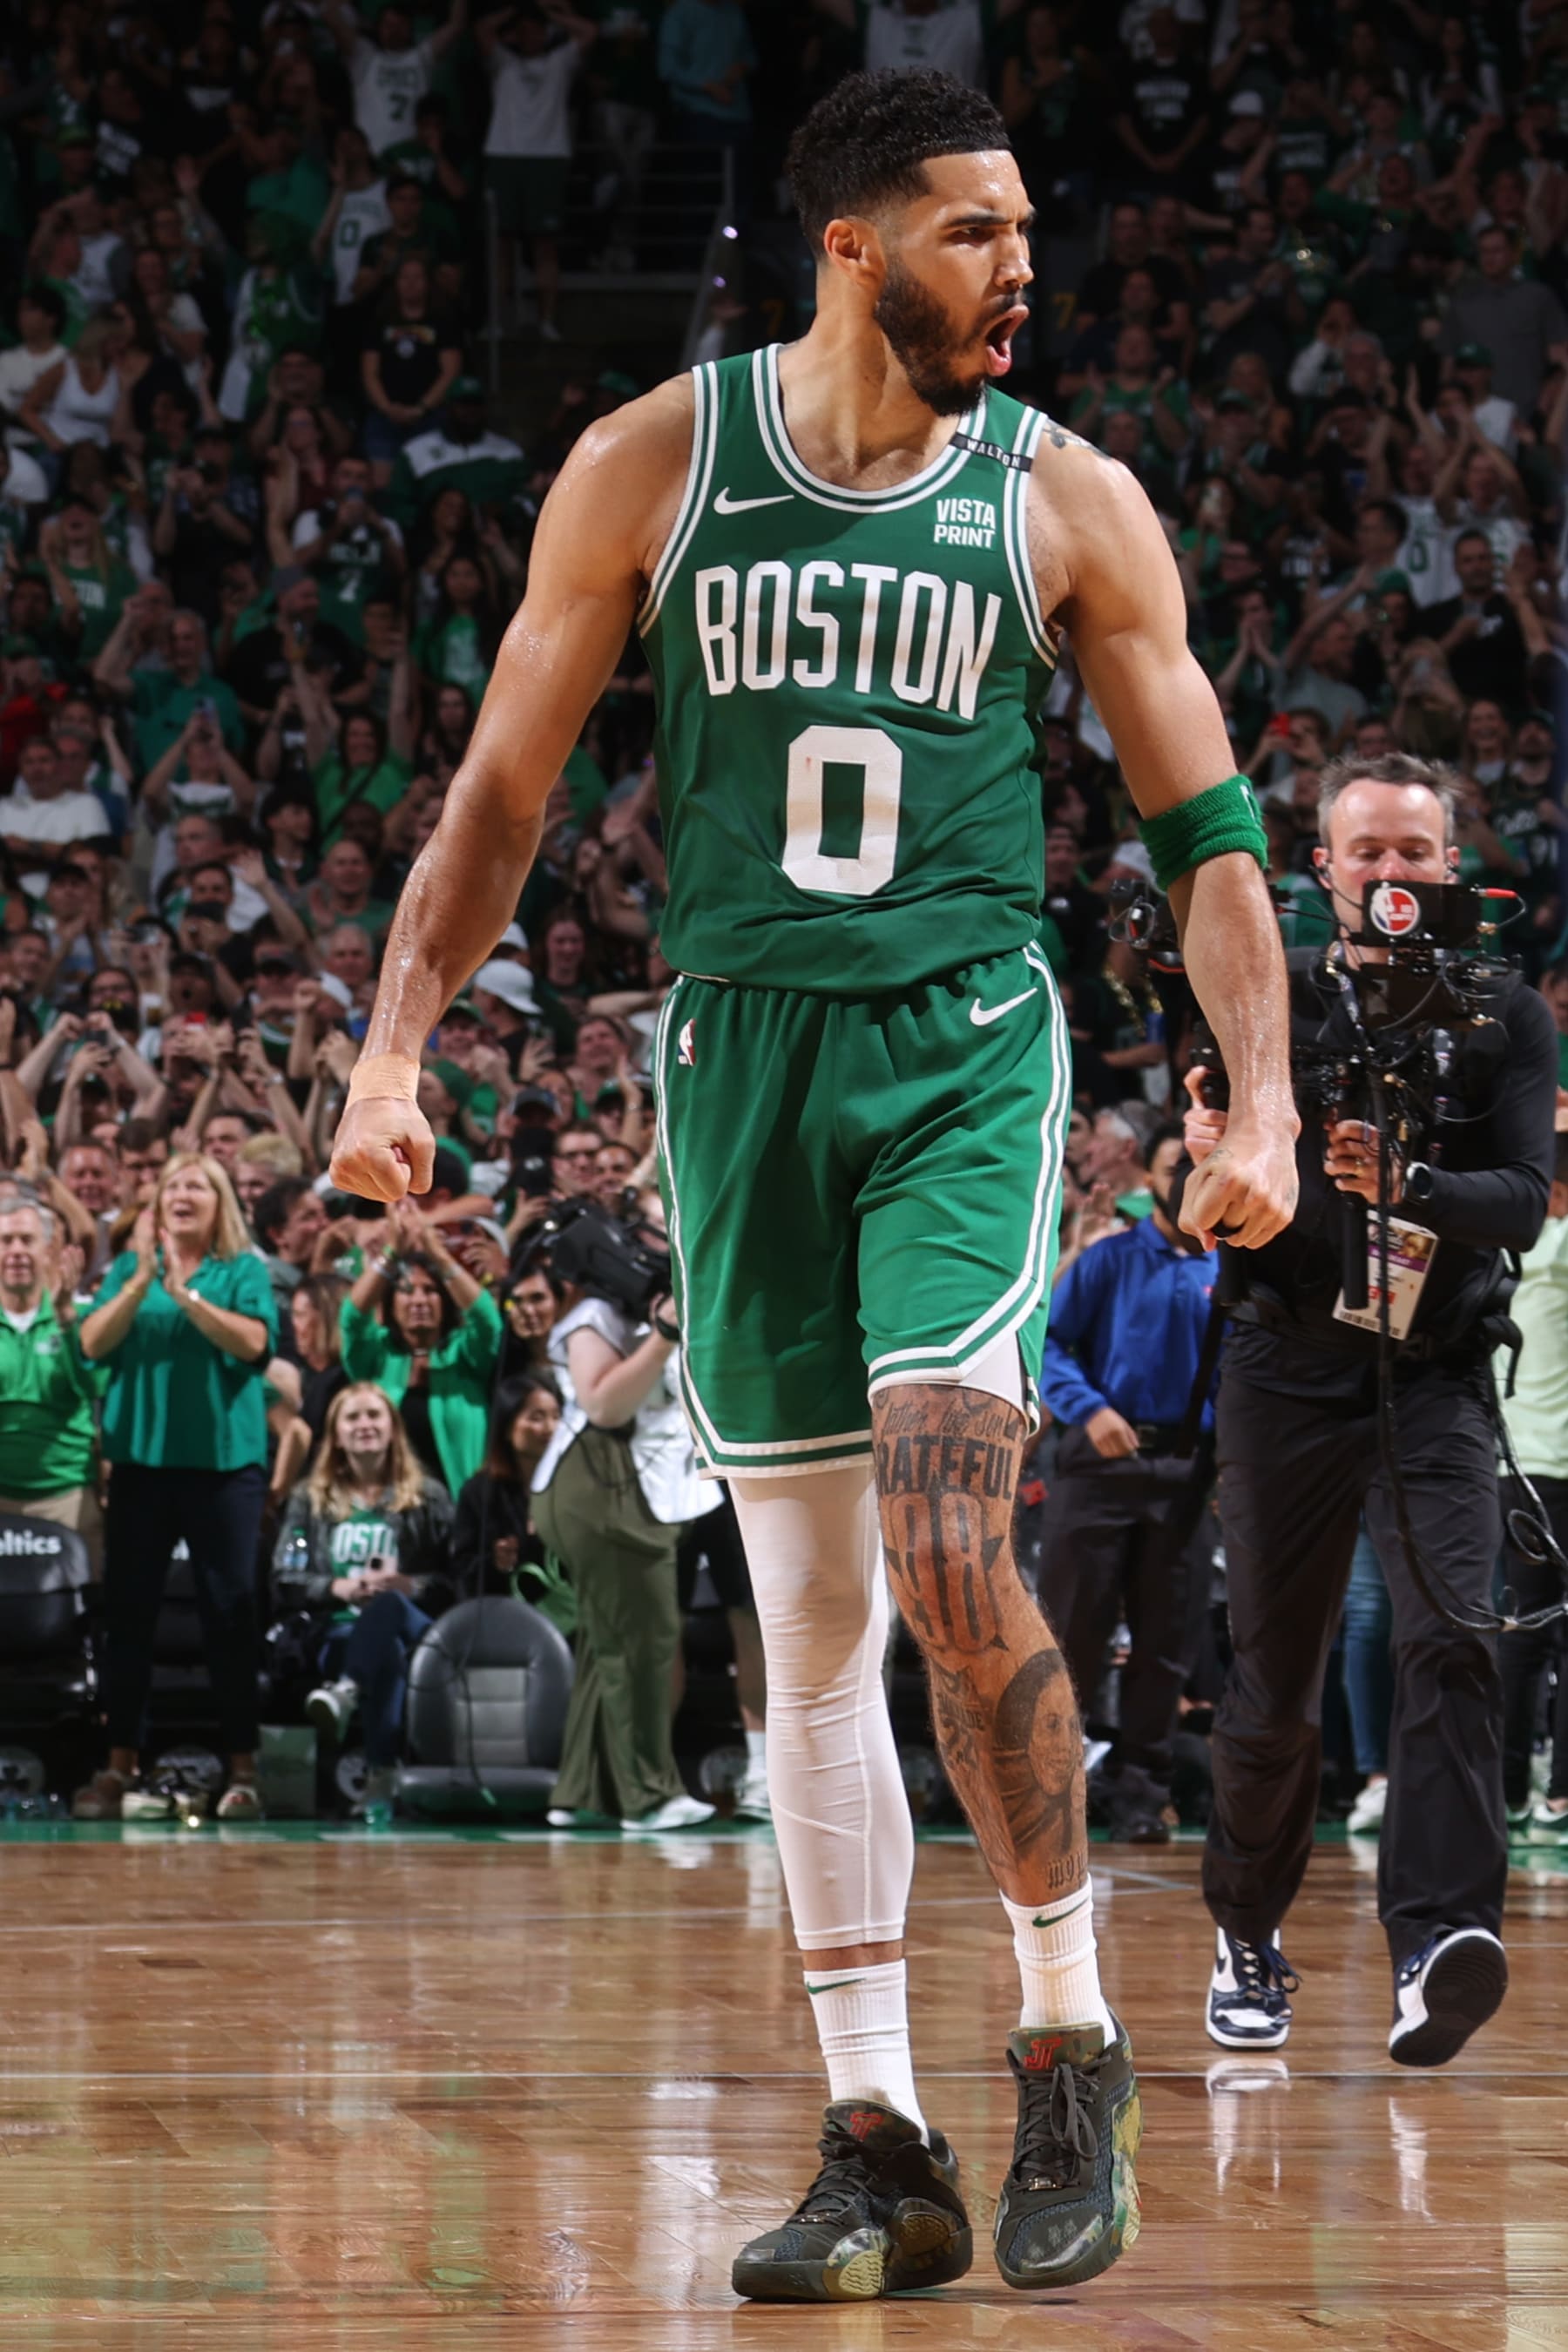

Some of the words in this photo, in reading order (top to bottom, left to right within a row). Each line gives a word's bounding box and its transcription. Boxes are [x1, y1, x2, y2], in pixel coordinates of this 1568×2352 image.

[1051, 293, 1078, 331] 7
[967, 438, 1021, 468] WALTON
[936, 497, 996, 530] VISTA
[933, 523, 996, 550] PRINT
[696, 560, 1002, 720] BOSTON
[781, 725, 902, 896] 0
[875, 1434, 1014, 1500] RATEFUL
[0, 1529, 62, 1556] ltics
